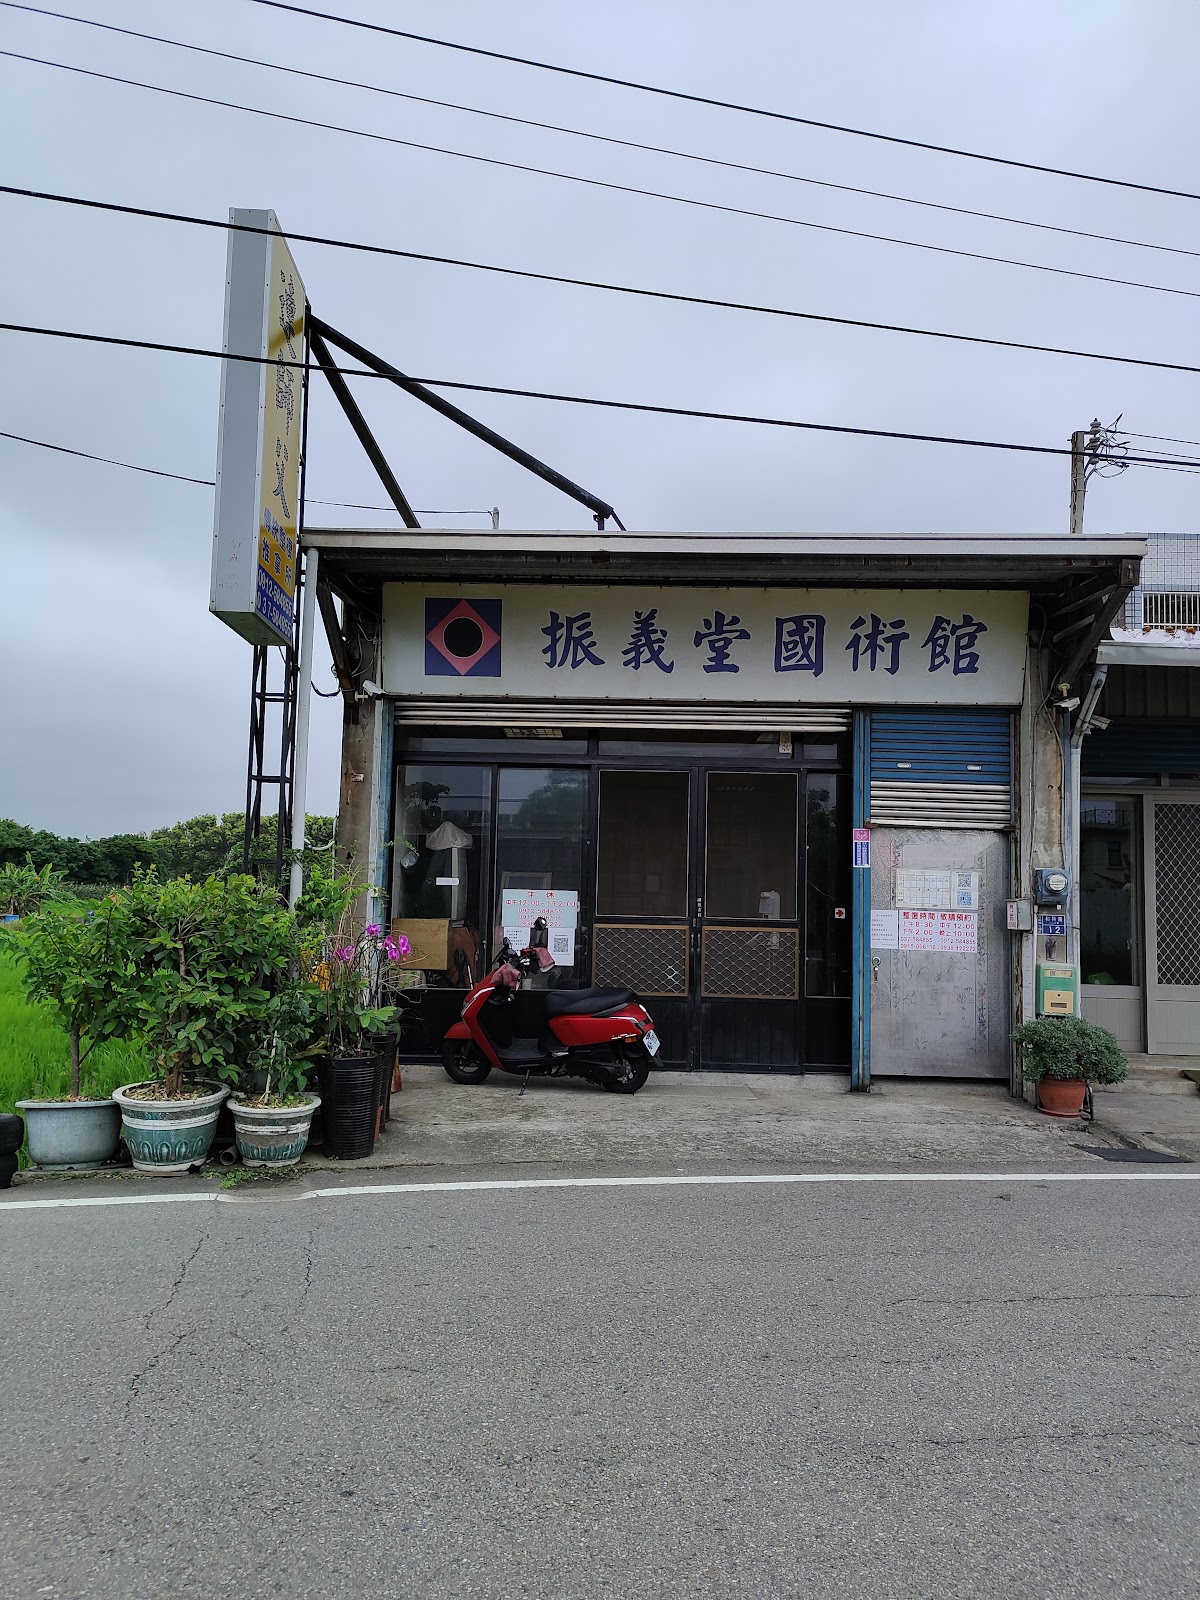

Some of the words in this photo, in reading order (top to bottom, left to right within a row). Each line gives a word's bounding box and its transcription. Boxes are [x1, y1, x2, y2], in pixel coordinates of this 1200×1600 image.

[541, 609, 988, 677] 振義堂國術館
[1048, 926, 1061, 934] 12
